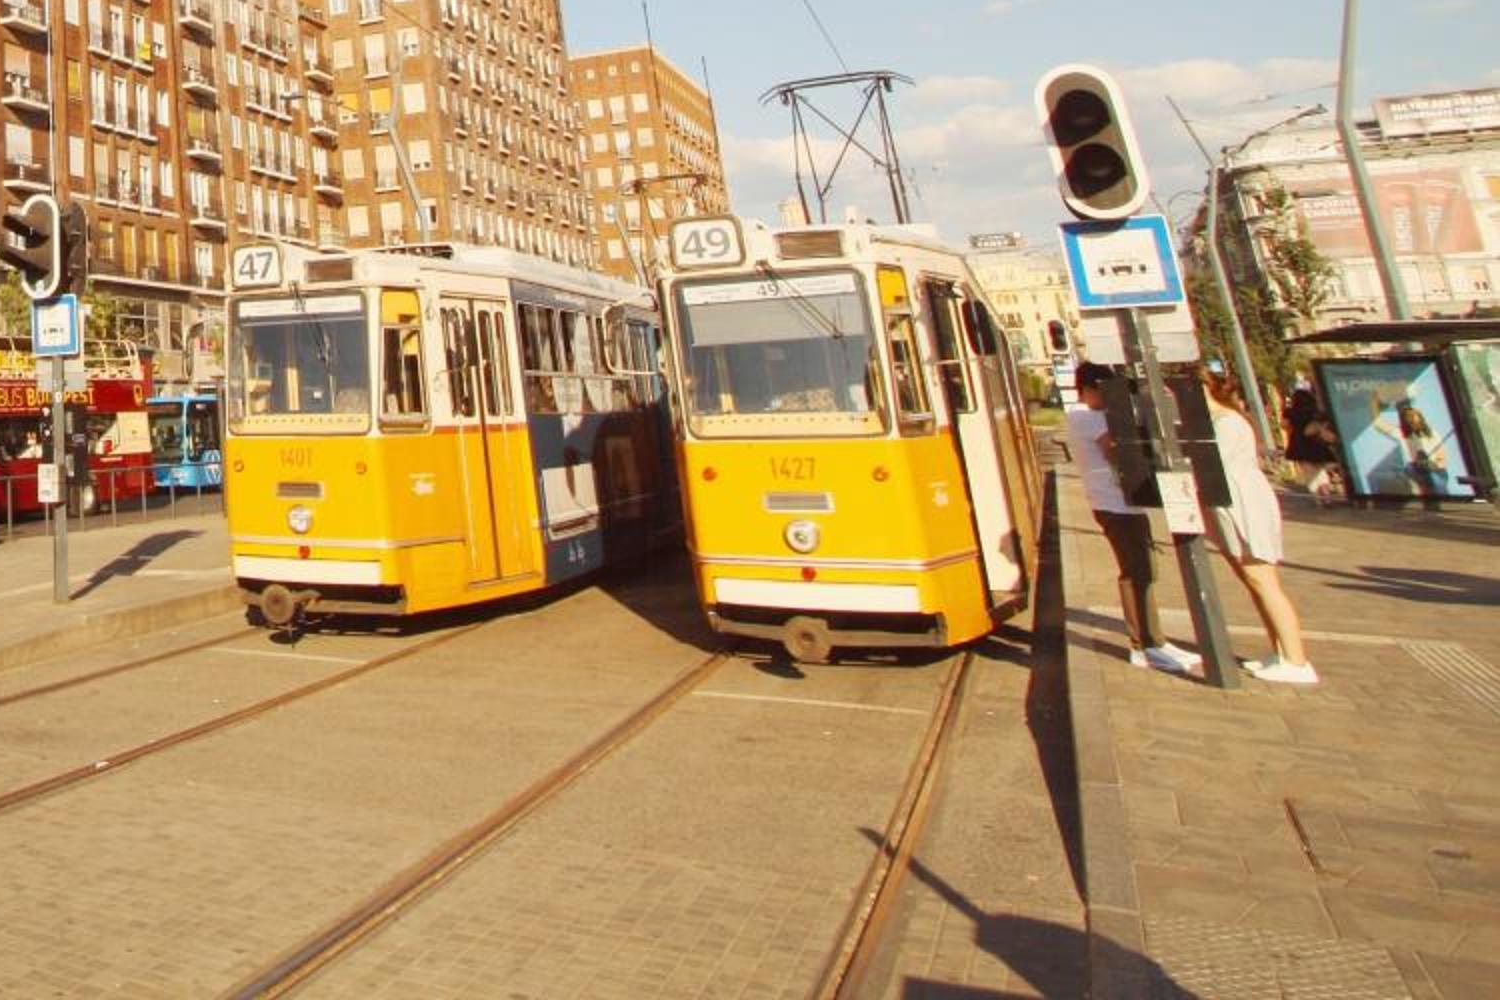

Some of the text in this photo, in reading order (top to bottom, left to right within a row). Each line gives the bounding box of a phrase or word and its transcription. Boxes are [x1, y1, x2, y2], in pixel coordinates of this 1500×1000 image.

[681, 227, 731, 259] 49
[239, 251, 273, 280] 47
[756, 281, 779, 298] 49
[769, 456, 816, 480] 1427
